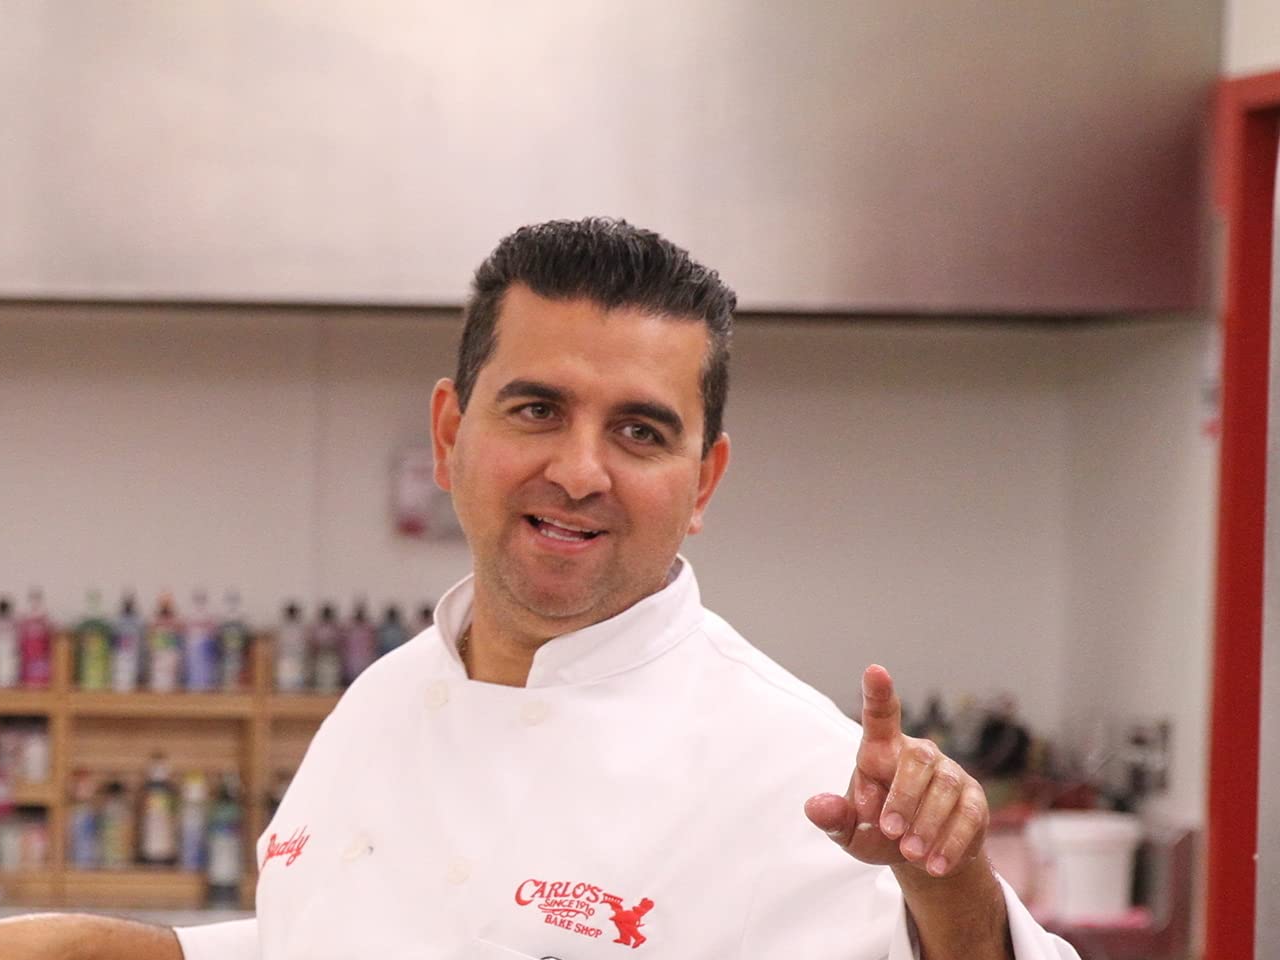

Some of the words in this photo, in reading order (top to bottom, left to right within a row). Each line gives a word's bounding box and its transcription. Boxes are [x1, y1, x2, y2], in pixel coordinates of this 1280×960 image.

[515, 878, 602, 906] CARLO'S
[544, 898, 574, 908] SINCE
[575, 900, 595, 917] 1910
[544, 914, 574, 930] BAKE
[574, 923, 603, 939] SHOP
